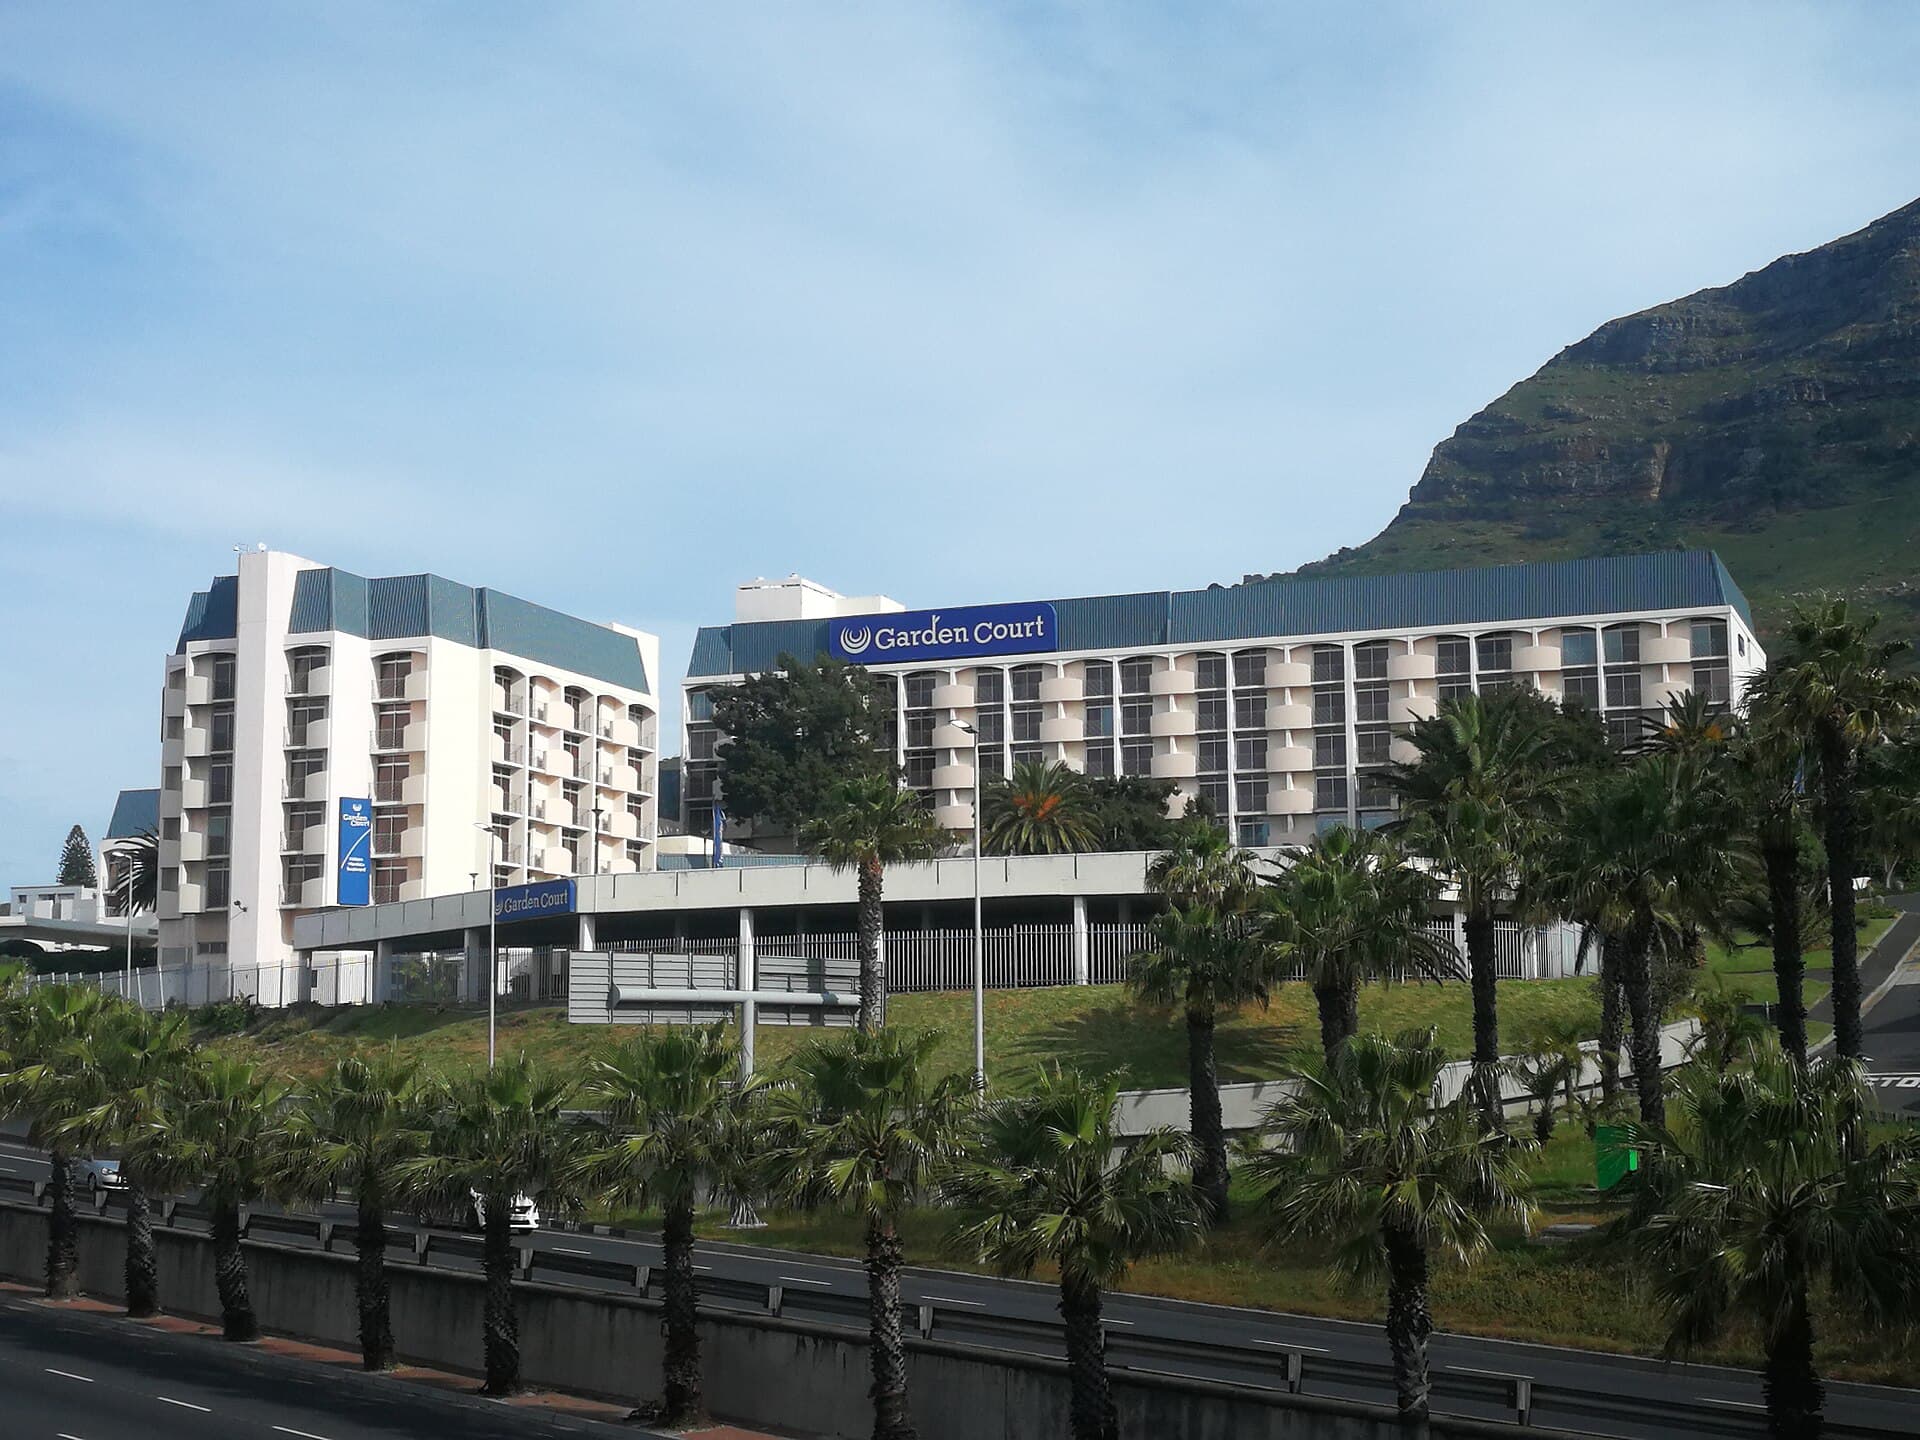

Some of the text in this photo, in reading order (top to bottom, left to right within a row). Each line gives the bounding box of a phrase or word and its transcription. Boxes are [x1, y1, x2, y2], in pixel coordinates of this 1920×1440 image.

[874, 614, 1044, 650] Garden Court
[504, 888, 568, 913] Garden Court
[1864, 1077, 1920, 1088] STO
